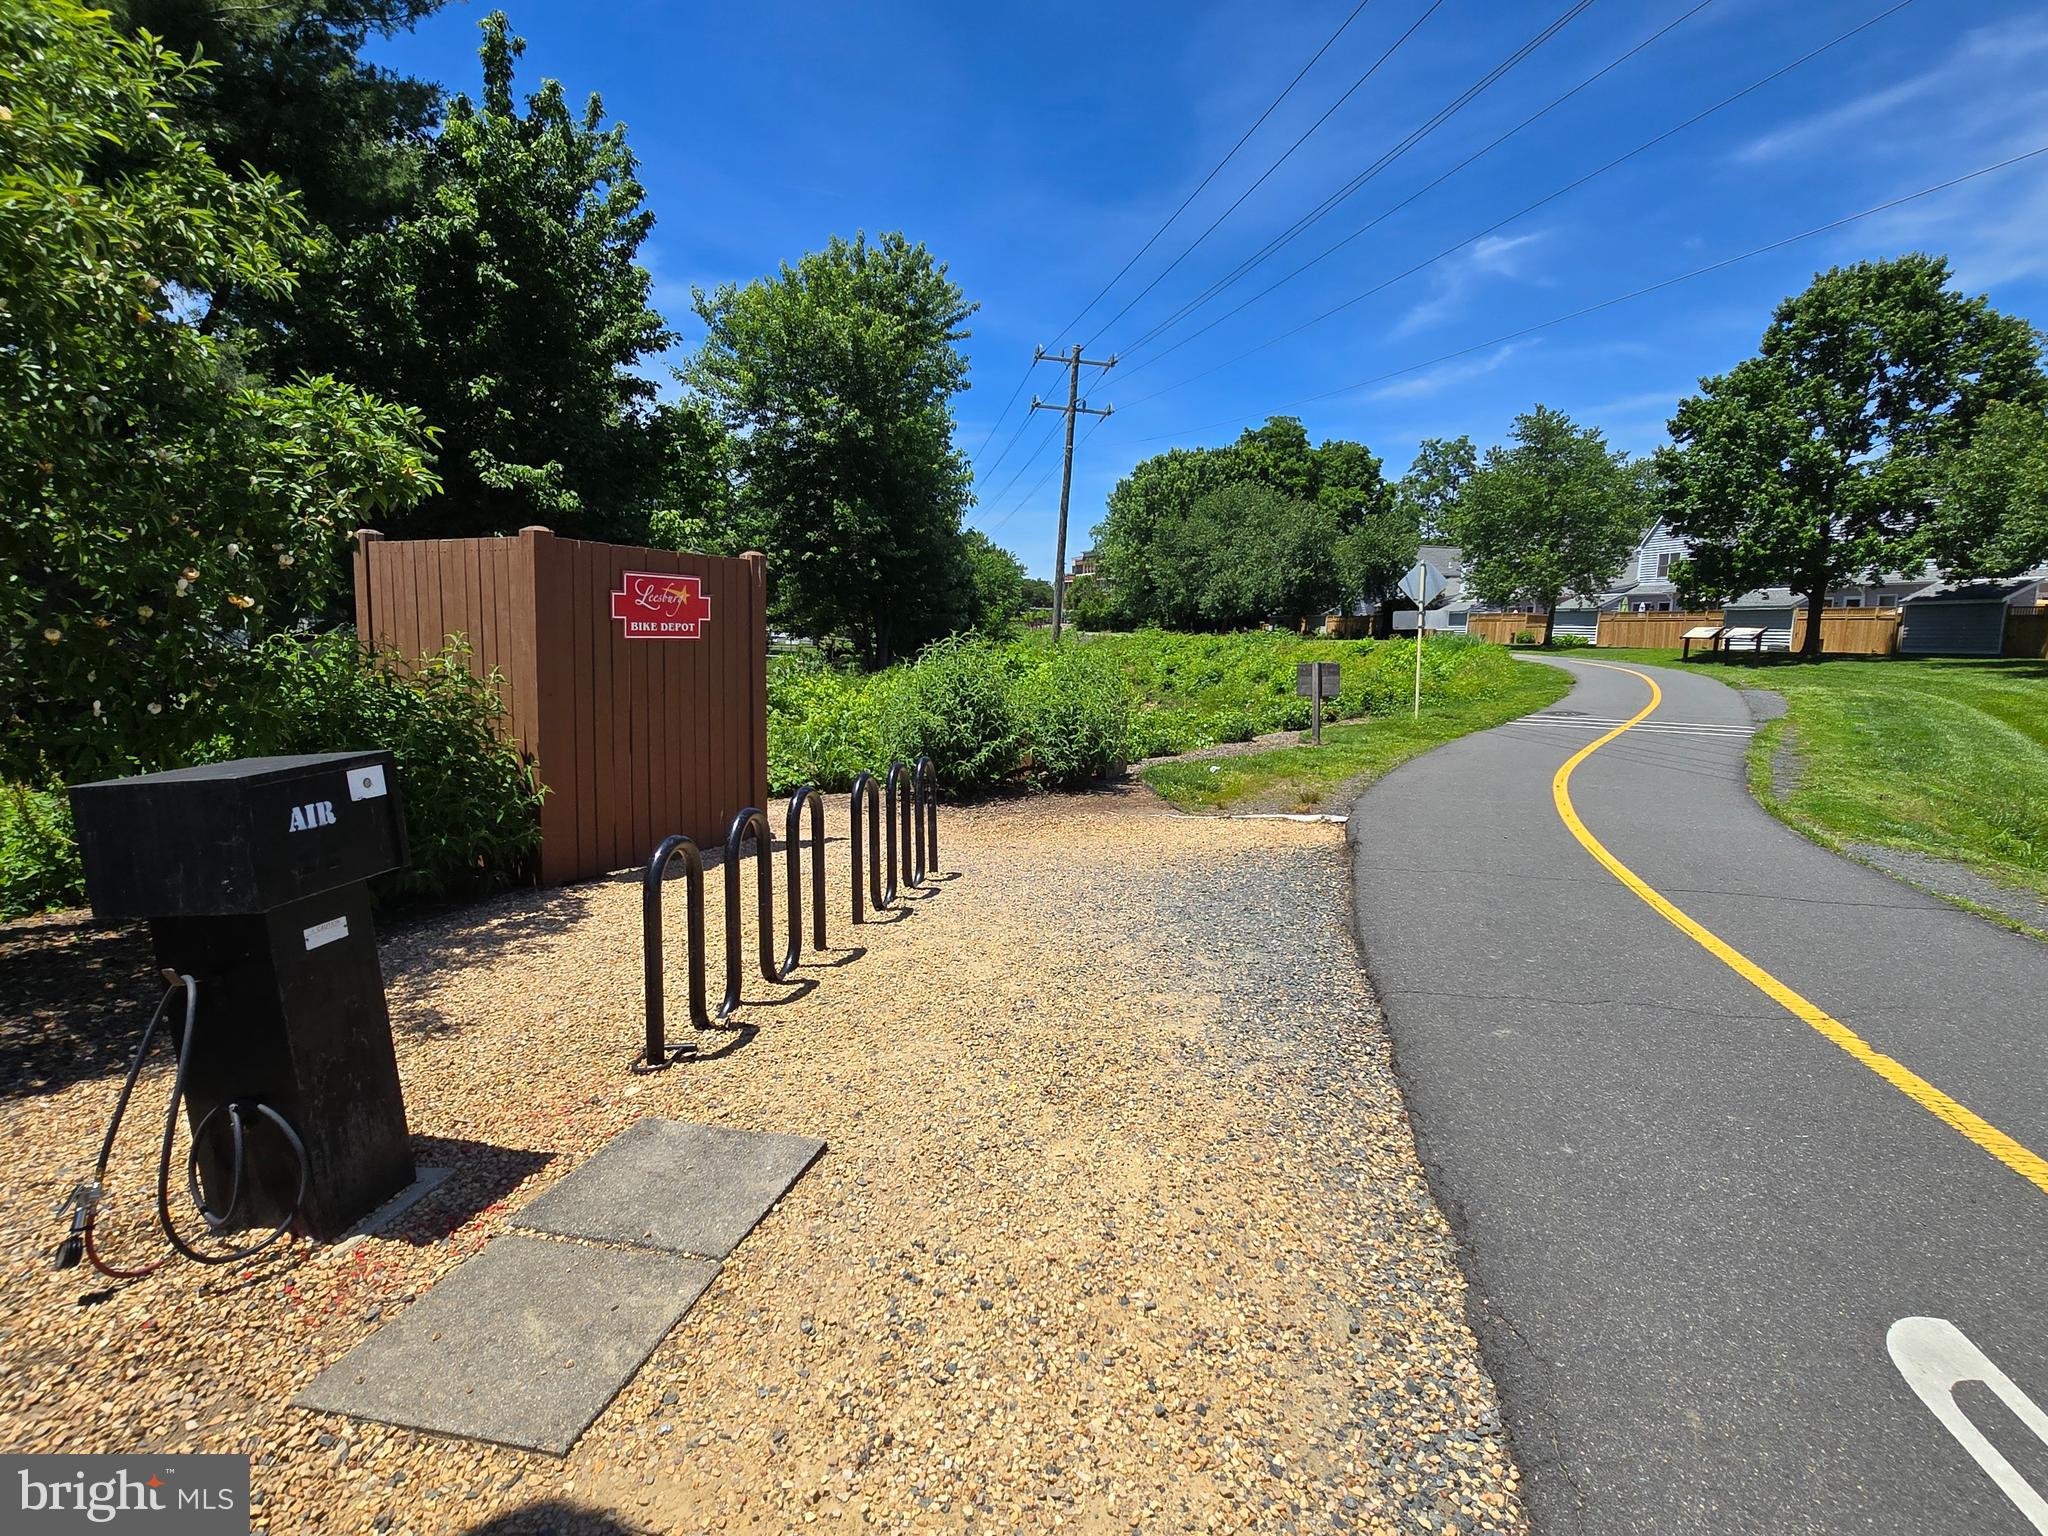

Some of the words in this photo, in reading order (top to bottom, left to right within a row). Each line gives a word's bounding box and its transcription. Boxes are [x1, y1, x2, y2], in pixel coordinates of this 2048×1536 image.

[631, 622, 657, 631] BIKE
[661, 622, 695, 632] DEPOT
[289, 800, 337, 832] AIR
